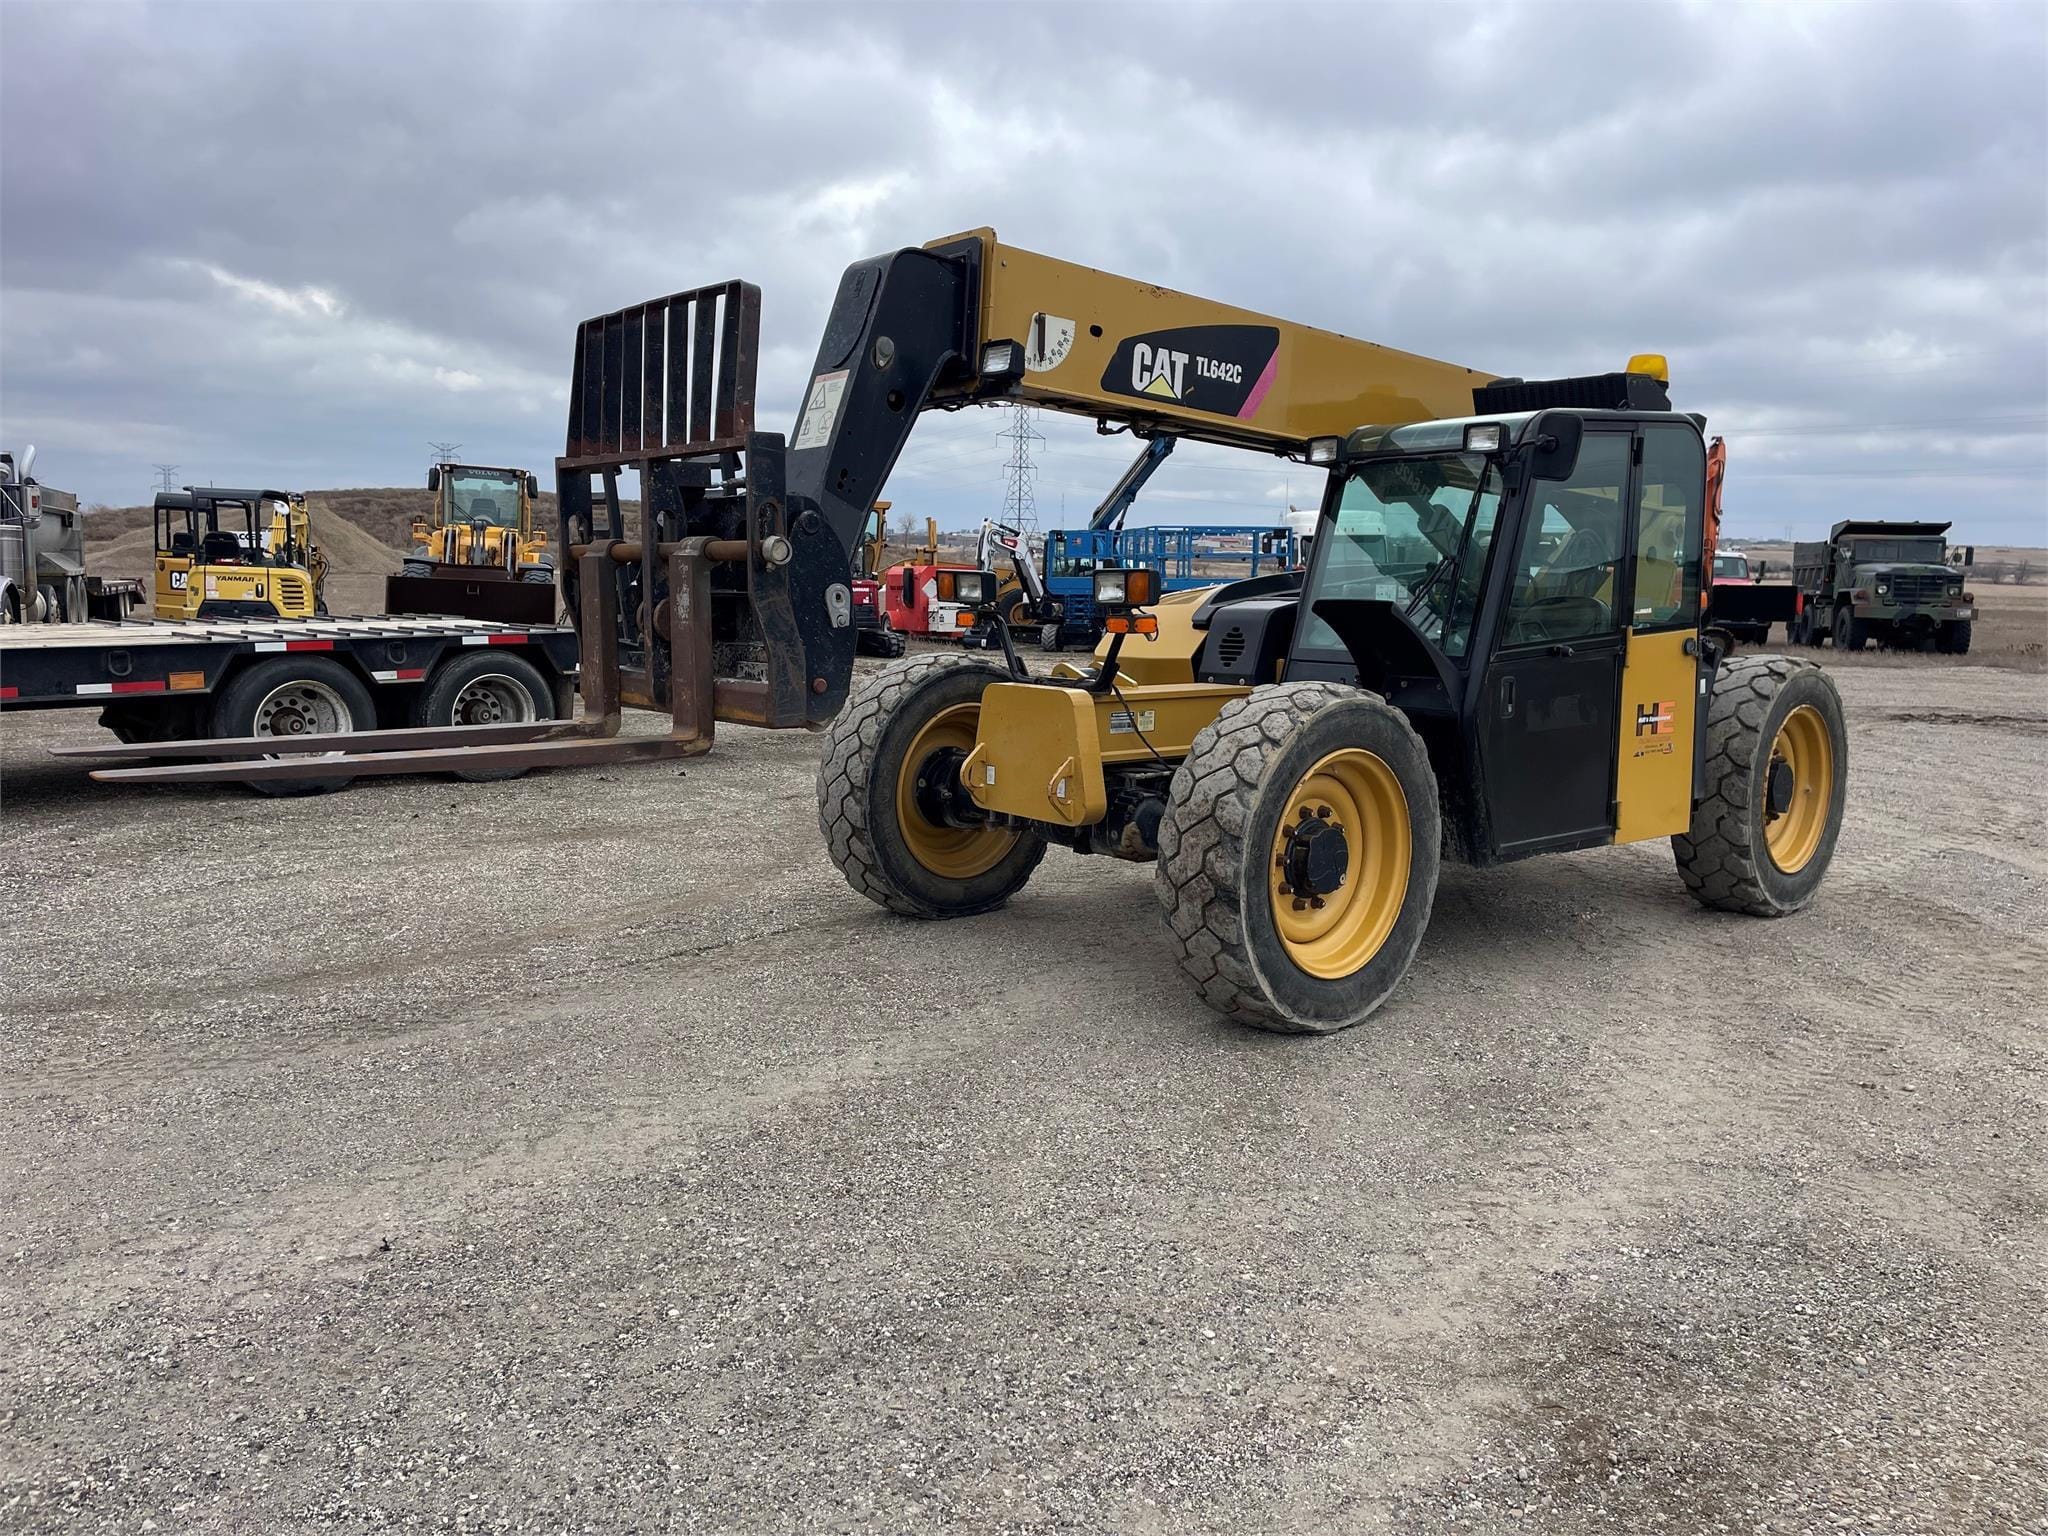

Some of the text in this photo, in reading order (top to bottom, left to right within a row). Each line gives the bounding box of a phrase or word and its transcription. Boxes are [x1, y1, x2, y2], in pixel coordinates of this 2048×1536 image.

[1132, 342, 1242, 399] CAT TL642C
[468, 469, 500, 477] VOLVO
[171, 572, 188, 589] CA
[216, 575, 255, 583] YANMAR
